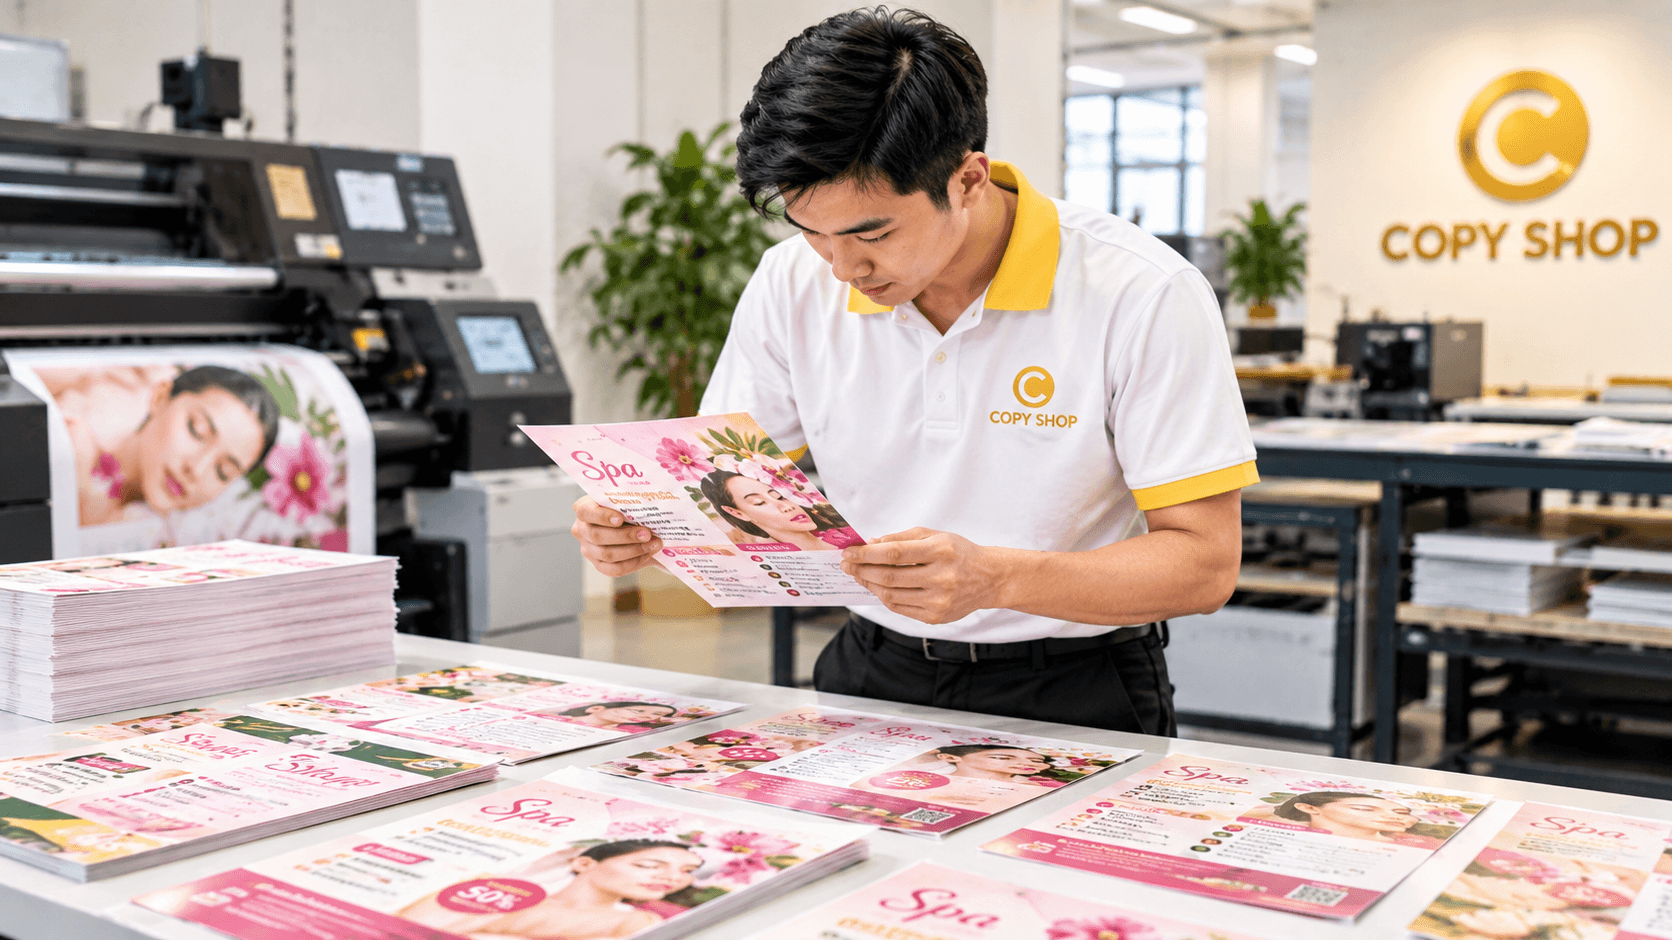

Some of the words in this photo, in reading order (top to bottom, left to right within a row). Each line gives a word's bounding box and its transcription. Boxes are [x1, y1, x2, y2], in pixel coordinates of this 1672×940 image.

[1381, 223, 1508, 262] COPY
[1524, 218, 1659, 259] SHOP
[989, 410, 1032, 426] COPY
[1035, 413, 1078, 429] SHOP
[570, 450, 644, 488] Spa
[1163, 765, 1249, 785] Spa
[479, 798, 576, 828] Spa
[1529, 816, 1629, 840] Spa
[878, 888, 1000, 928] Spa
